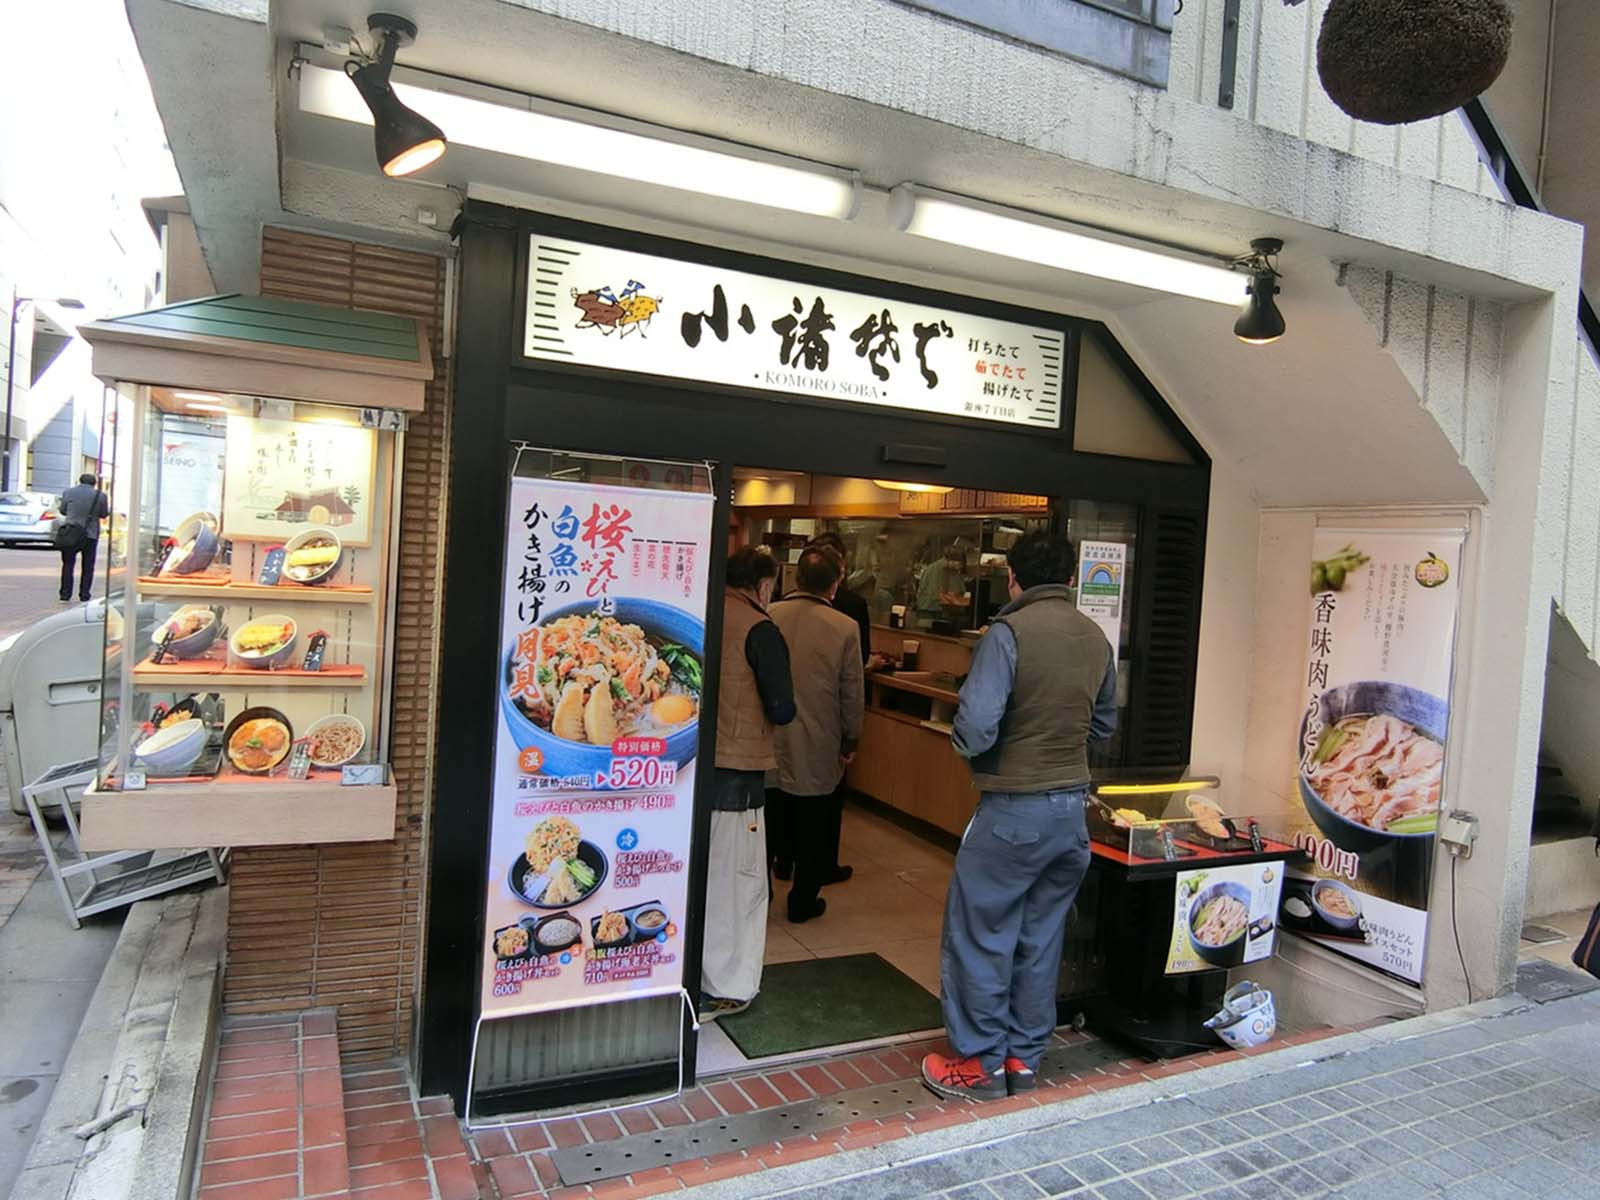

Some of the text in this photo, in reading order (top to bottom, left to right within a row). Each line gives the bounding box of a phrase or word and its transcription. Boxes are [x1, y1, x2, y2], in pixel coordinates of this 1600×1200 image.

[968, 338, 1020, 360] 打ちたて
[765, 370, 879, 399] KOMORO SOBA
[975, 360, 1027, 381] 茹でたて
[983, 381, 1035, 402] 揚げたて
[547, 504, 581, 594] 白魚の
[581, 503, 634, 615] 桜えびと
[509, 502, 549, 700] かき揚げ 月見
[1300, 593, 1336, 774] 香味肉うどん
[617, 741, 662, 753] 特別価格
[518, 776, 590, 789] 通常価格 540円
[610, 759, 675, 788] 520円
